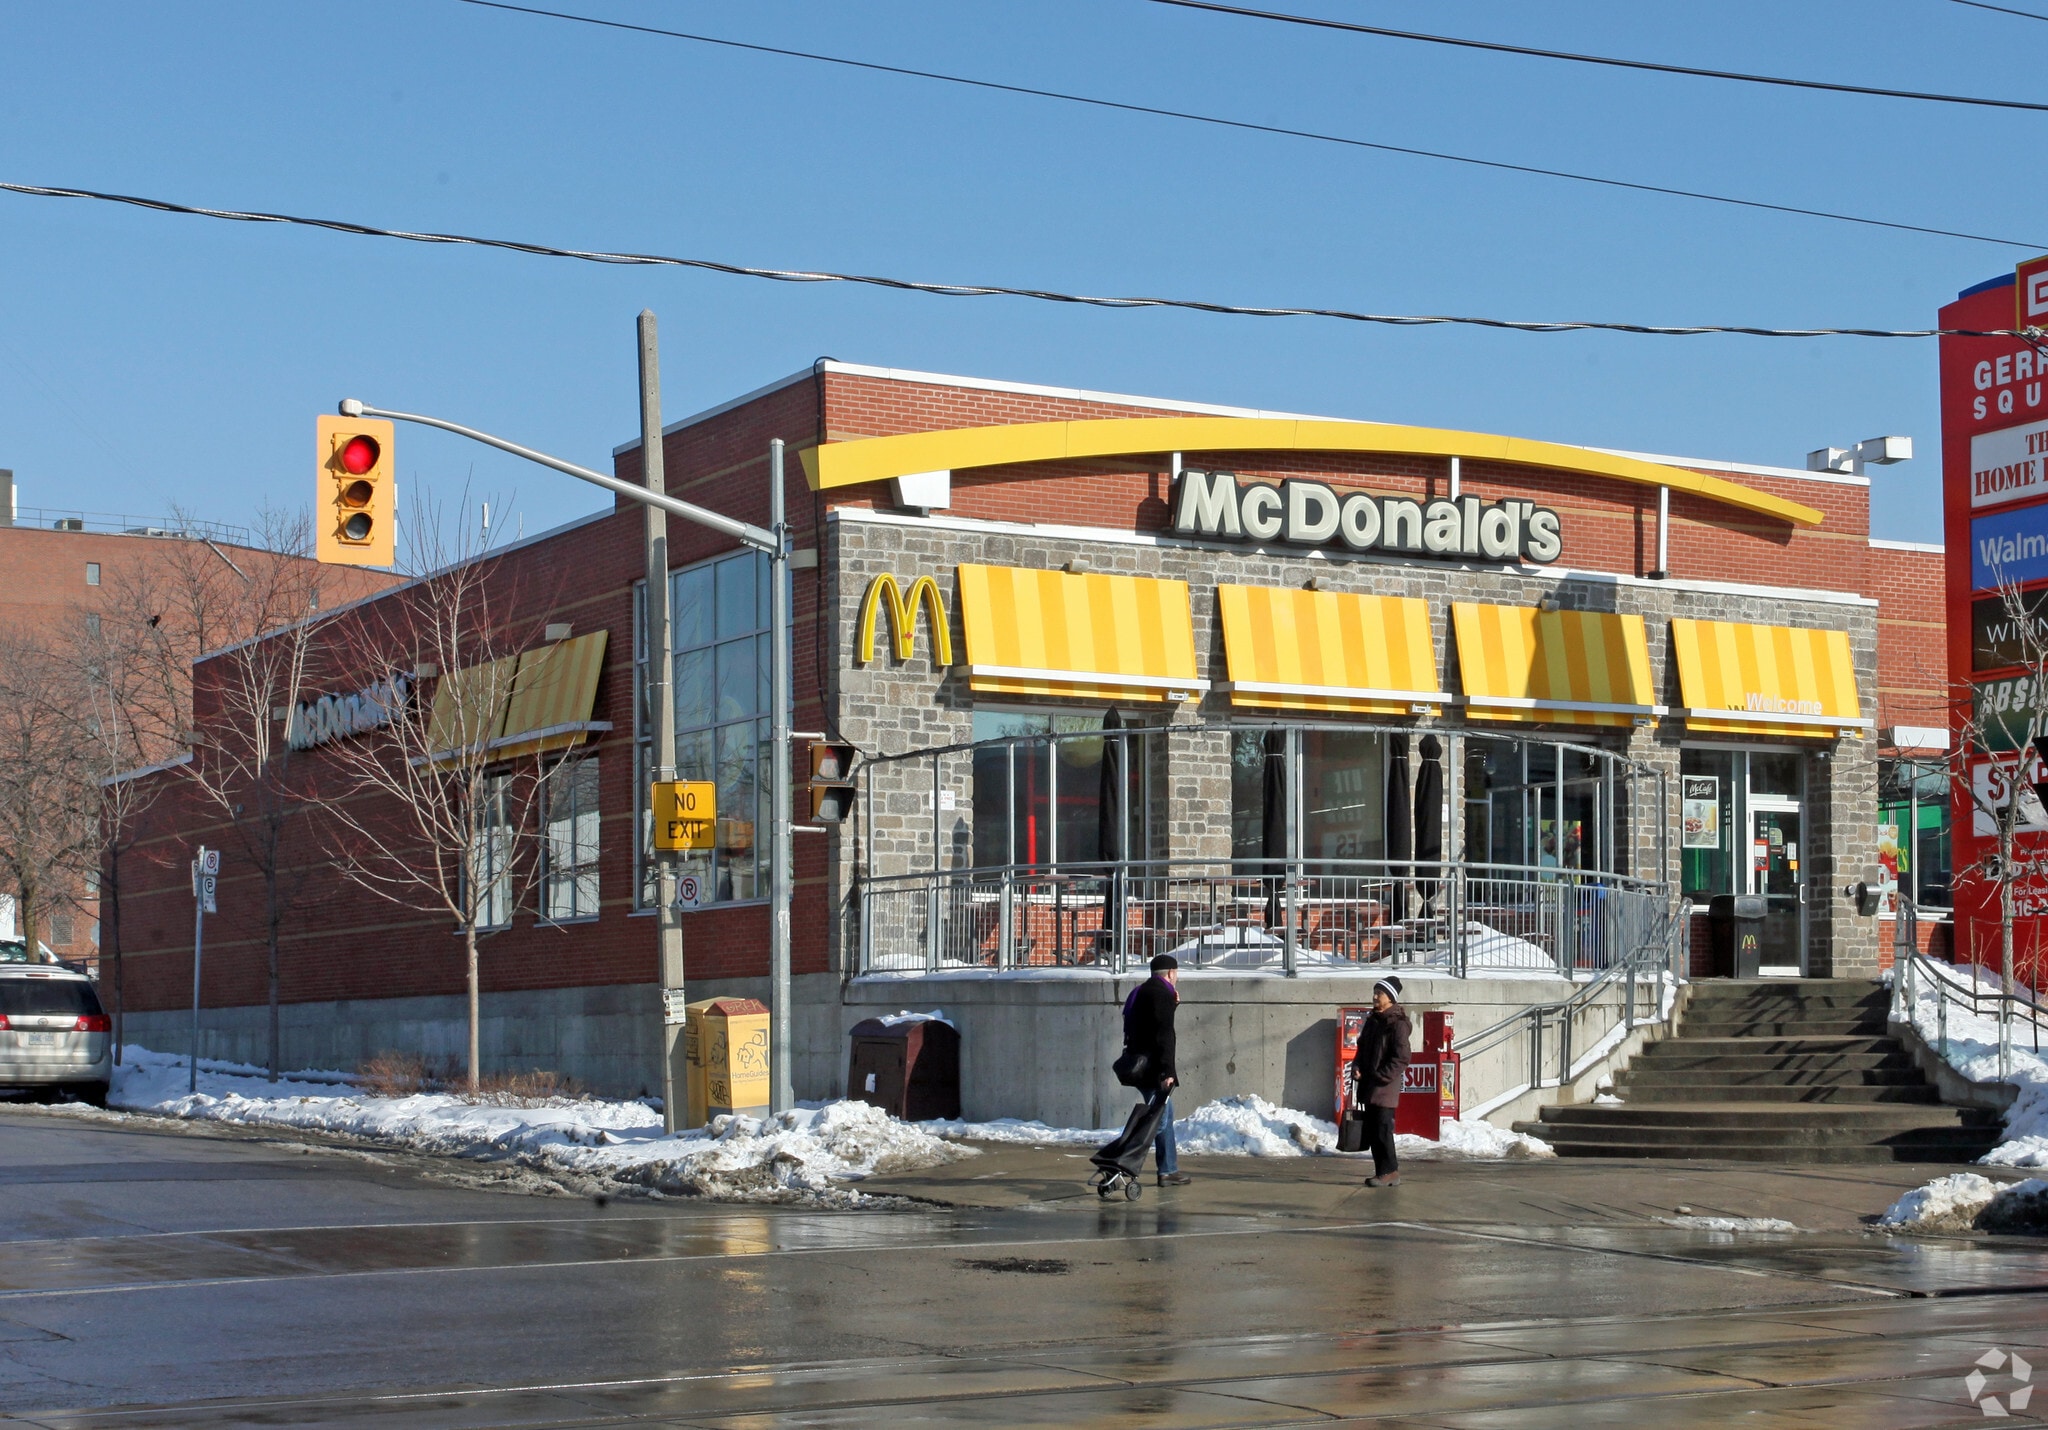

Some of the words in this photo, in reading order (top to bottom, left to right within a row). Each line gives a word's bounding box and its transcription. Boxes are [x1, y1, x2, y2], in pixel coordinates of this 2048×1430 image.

[1975, 460, 2036, 496] HOME
[1175, 470, 1562, 563] McDonald's
[1980, 532, 2048, 566] Walm
[1745, 692, 1823, 715] Welcome
[675, 792, 696, 811] NO
[668, 820, 704, 839] EXIT
[1404, 1066, 1436, 1087] SUN
